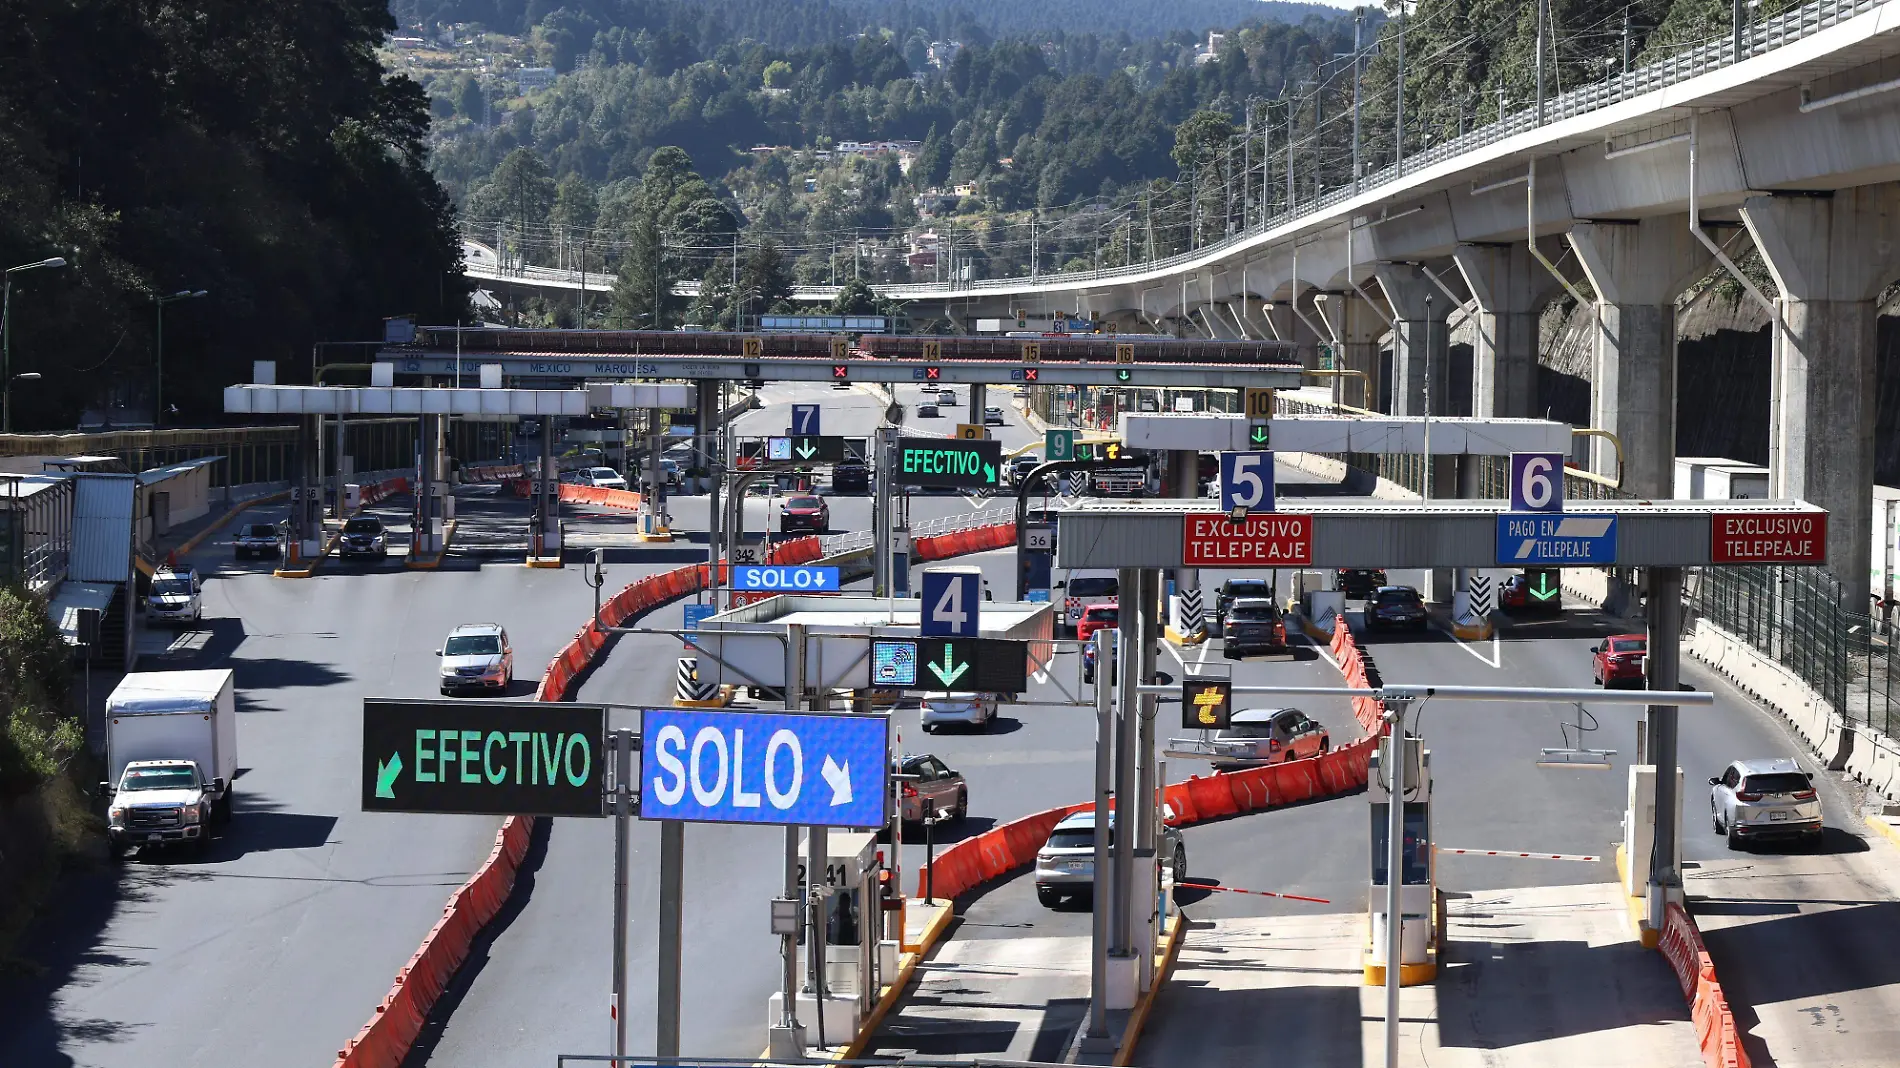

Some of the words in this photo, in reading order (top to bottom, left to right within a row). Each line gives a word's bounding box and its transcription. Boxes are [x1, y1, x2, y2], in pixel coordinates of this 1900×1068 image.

[745, 342, 758, 356] 12
[834, 343, 846, 357] 13
[925, 344, 938, 359] 14
[1025, 346, 1037, 360] 15
[1119, 347, 1132, 361] 16
[530, 363, 571, 373] MEXICO
[595, 363, 658, 374] MARQUESA
[1249, 391, 1270, 415] 10
[797, 405, 815, 434] 7
[1054, 433, 1064, 457] 9
[904, 449, 980, 475] EFECTIVO
[1231, 455, 1264, 509] 5
[1522, 456, 1553, 509] 6
[1196, 521, 1302, 537] EXCLUSIVO
[1508, 521, 1535, 538] PAGO
[1541, 521, 1554, 538] EN
[1725, 519, 1813, 536] EXCLUSIVO
[1192, 542, 1305, 558] TELEPEAJE
[1537, 541, 1591, 558] TELEPEAJE
[1725, 540, 1813, 557] TELEPEAJE
[746, 568, 812, 588] SOLO
[932, 576, 968, 634] 4
[415, 729, 591, 787] EFECTIVO
[653, 725, 803, 809] SOLO
